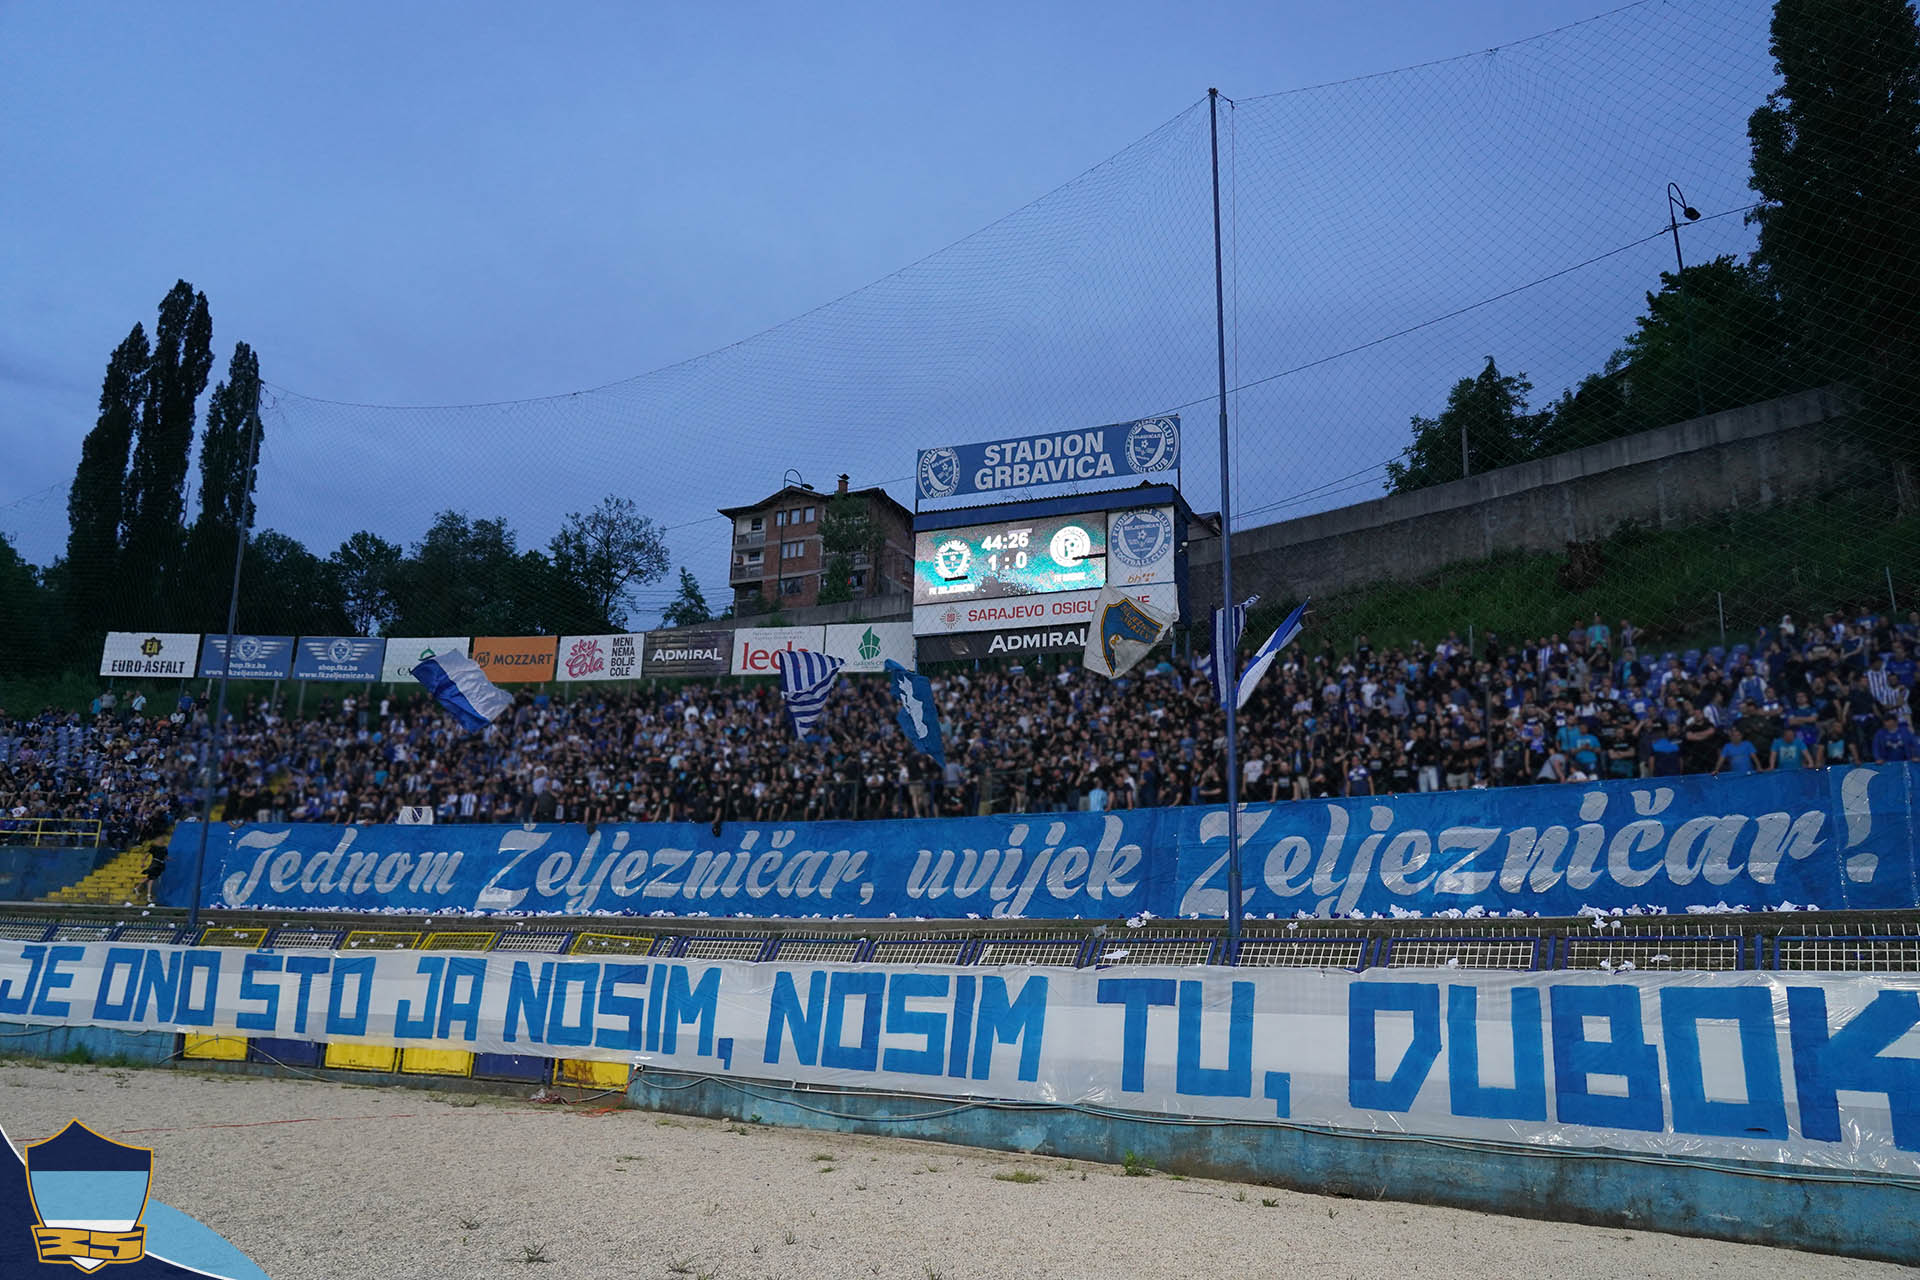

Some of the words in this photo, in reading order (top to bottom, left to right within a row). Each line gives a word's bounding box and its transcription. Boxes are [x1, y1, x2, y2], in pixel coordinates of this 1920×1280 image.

[984, 431, 1103, 466] STADION
[974, 454, 1115, 490] GRBAVICA
[981, 532, 1029, 551] 44:26
[988, 555, 997, 571] 1
[1015, 551, 1027, 569] 0
[968, 604, 1045, 622] SARAJEVO
[570, 639, 603, 656] sky
[612, 637, 634, 647] MENI
[988, 628, 1087, 654] ADMIRAL
[493, 654, 553, 666] MOZZART
[611, 647, 635, 657] NEMA
[652, 648, 723, 662] ADMIRAL
[111, 660, 185, 674] EURO-ASFALT
[228, 661, 267, 670] hop.fkz.ba
[565, 653, 605, 678] Cola
[610, 657, 635, 667] BOLJE
[609, 667, 631, 677] COLE
[222, 828, 464, 905] Jednom
[474, 823, 874, 915] Željezničar,
[906, 815, 1142, 920] uvijek
[0, 946, 86, 1018] JE
[93, 948, 221, 1028] ONO
[236, 948, 376, 1039] ŠTO
[394, 956, 487, 1042] JA
[503, 961, 733, 1071] NOSIM,
[764, 970, 1048, 1082] NOSIM
[1097, 978, 1290, 1119] TU,
